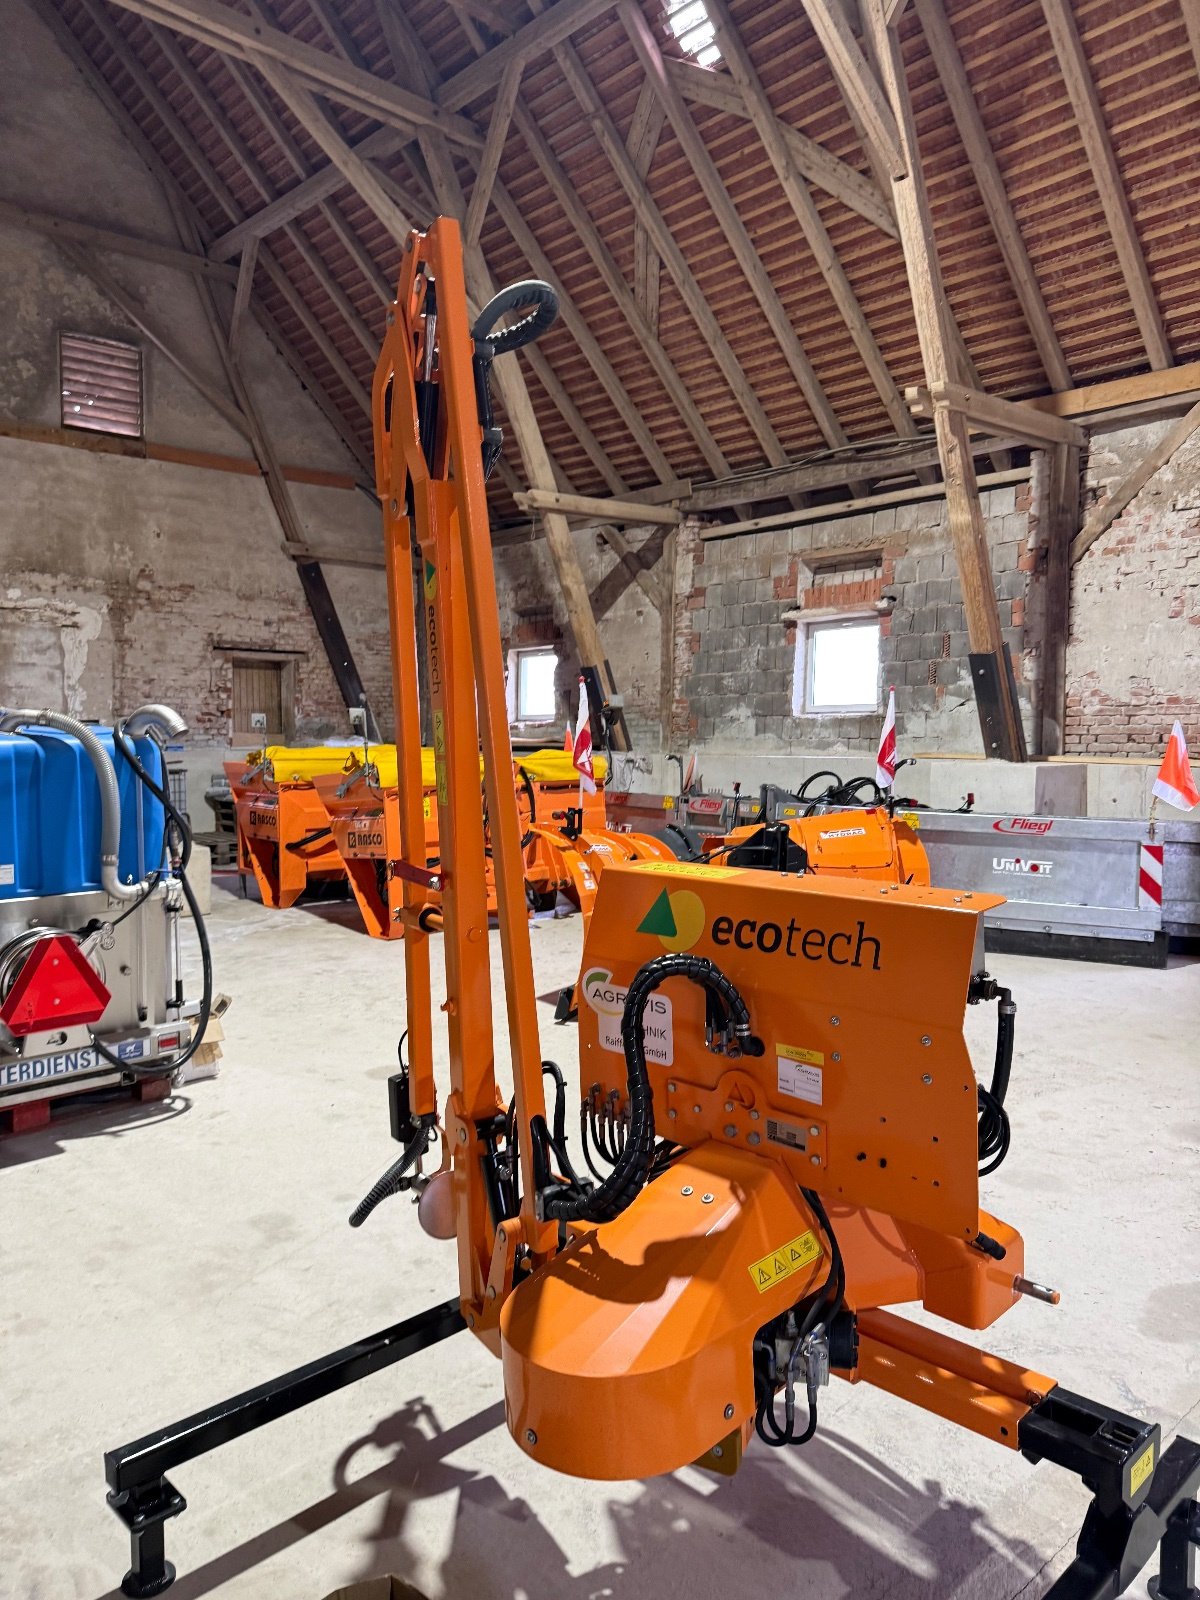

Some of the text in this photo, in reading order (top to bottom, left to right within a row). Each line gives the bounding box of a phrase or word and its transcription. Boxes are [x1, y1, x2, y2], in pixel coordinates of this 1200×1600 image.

[428, 604, 441, 695] ecotech
[700, 798, 723, 812] Fliegl
[256, 814, 277, 826] RASCO
[1010, 818, 1054, 833] Fliegl
[357, 834, 383, 846] RASCO
[711, 915, 881, 970] ecotech
